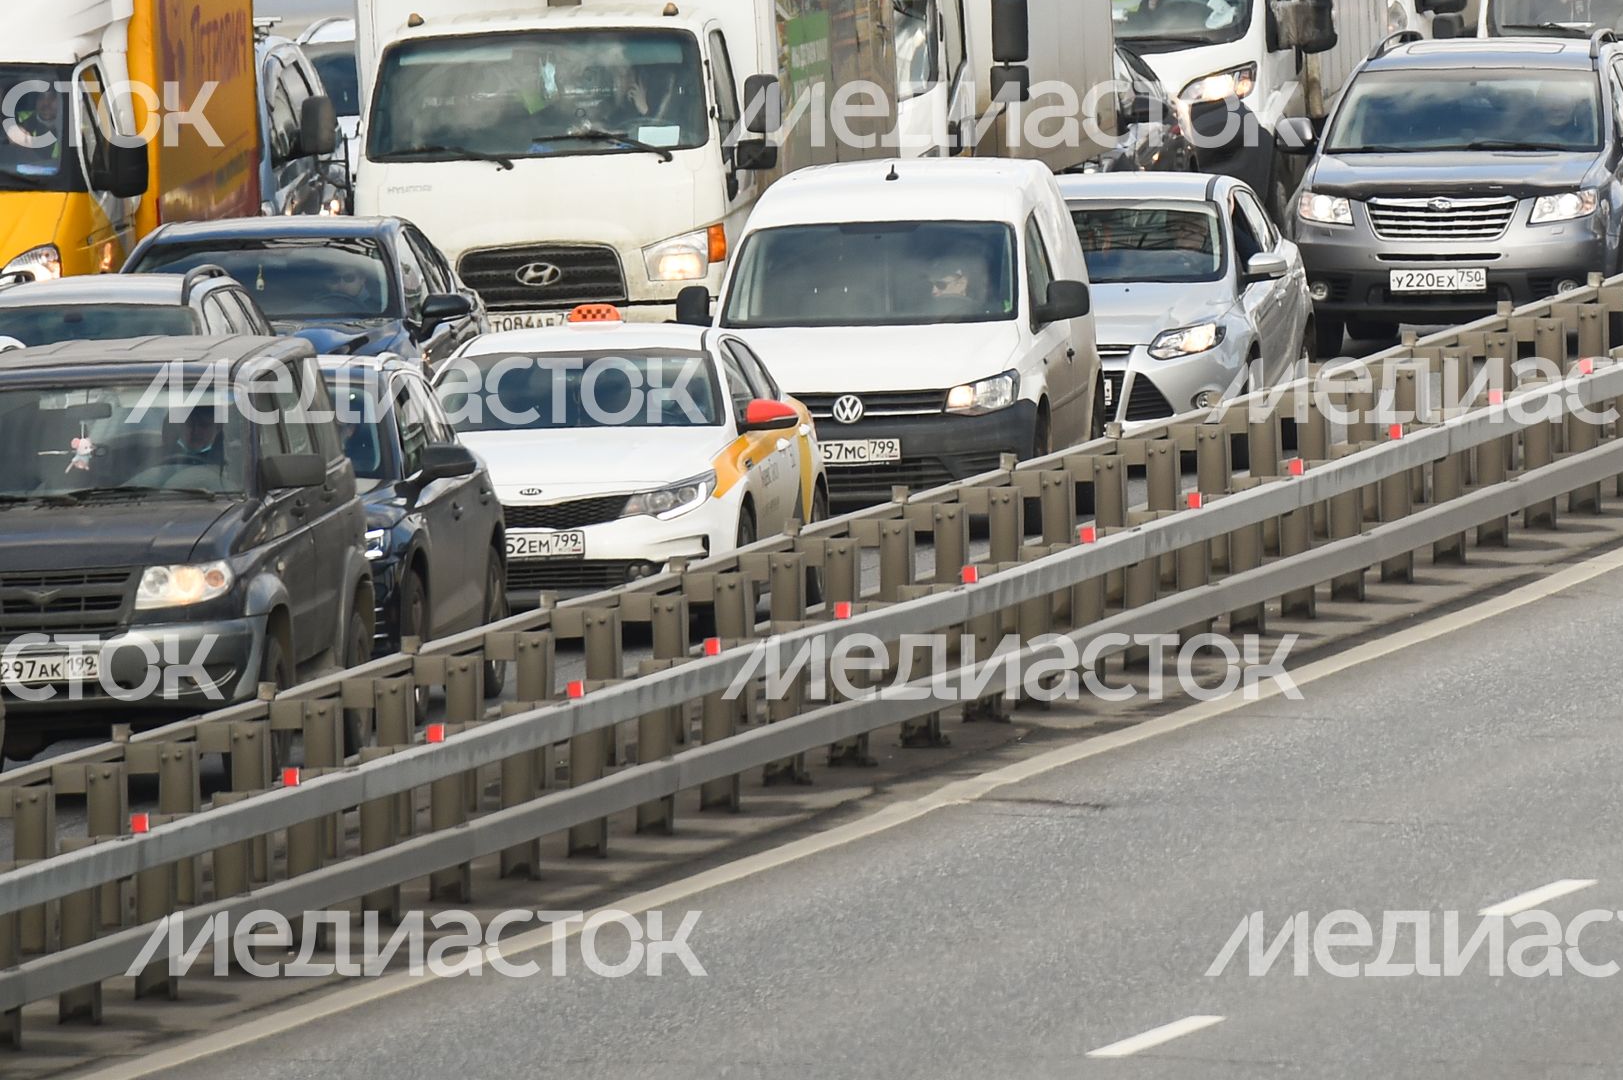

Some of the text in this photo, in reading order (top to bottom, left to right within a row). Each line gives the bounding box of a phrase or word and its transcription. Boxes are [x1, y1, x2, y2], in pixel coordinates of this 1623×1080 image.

[1396, 271, 1482, 288] У220ЕХ 750
[818, 441, 894, 460] 57МС 799
[553, 534, 578, 548] 799
